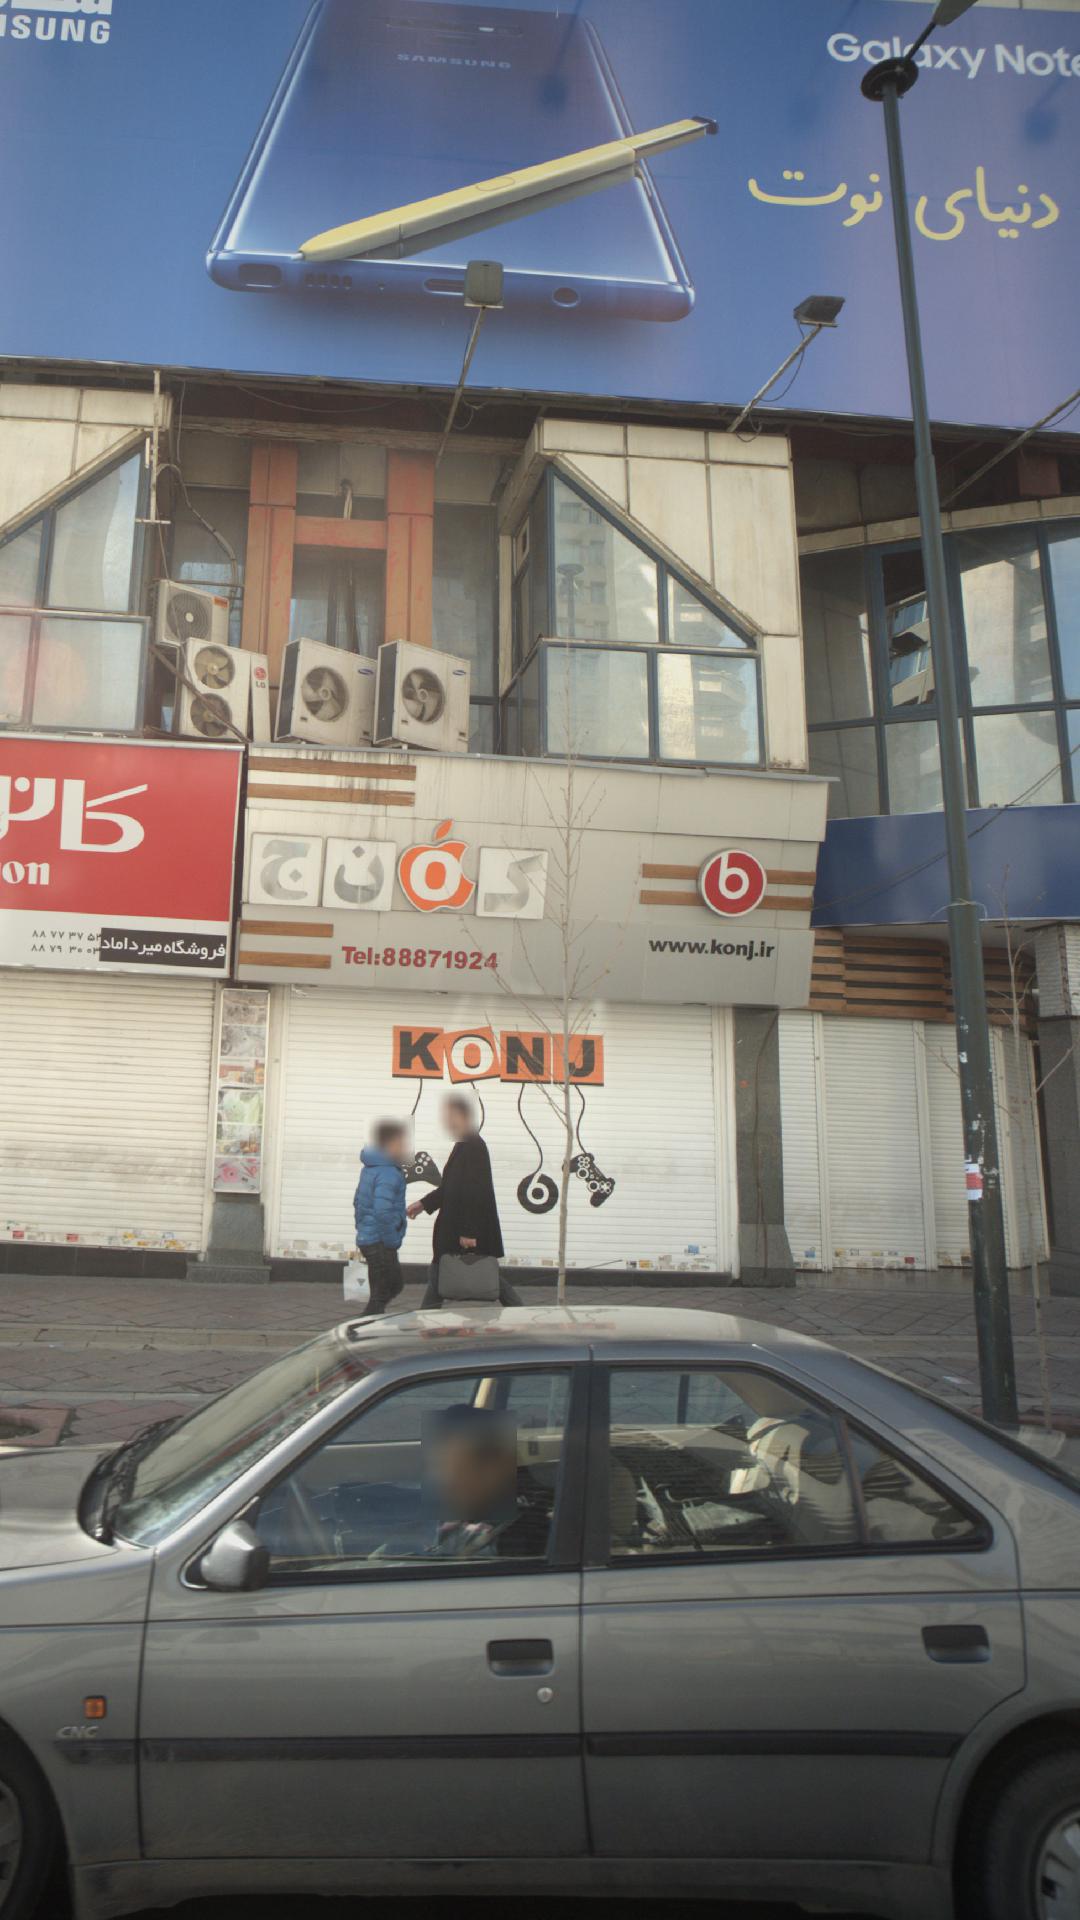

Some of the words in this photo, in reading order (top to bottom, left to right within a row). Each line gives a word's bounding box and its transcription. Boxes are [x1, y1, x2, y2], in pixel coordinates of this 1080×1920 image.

[396, 53, 512, 69] SAMSUNG
[826, 32, 986, 79] Galaxy
[747, 169, 884, 227] نوت
[914, 166, 1060, 241] دنیای
[255, 681, 266, 689] LG
[101, 937, 162, 956] میرداماد
[164, 940, 226, 960] فروشگاه
[341, 946, 498, 970] Tel:88871924
[648, 938, 775, 961] www.konj.ir
[399, 1031, 595, 1078] KONJ
